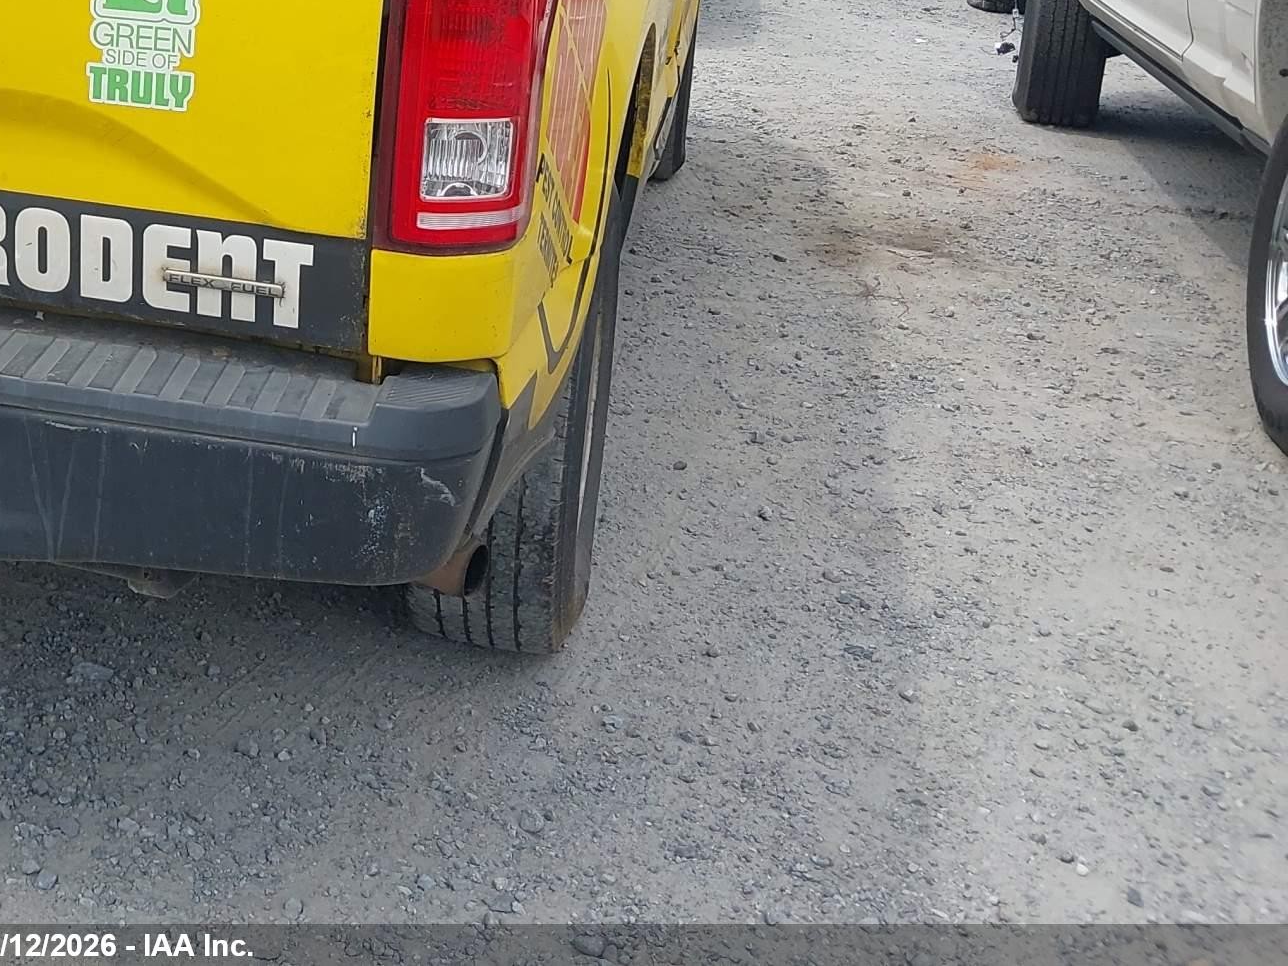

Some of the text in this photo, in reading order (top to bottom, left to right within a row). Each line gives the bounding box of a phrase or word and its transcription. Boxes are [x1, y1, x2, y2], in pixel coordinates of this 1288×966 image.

[93, 21, 192, 55] GREEN
[105, 48, 178, 70] SIDE OF
[89, 65, 192, 108] TRULY
[168, 273, 279, 297] FLEX FUEL
